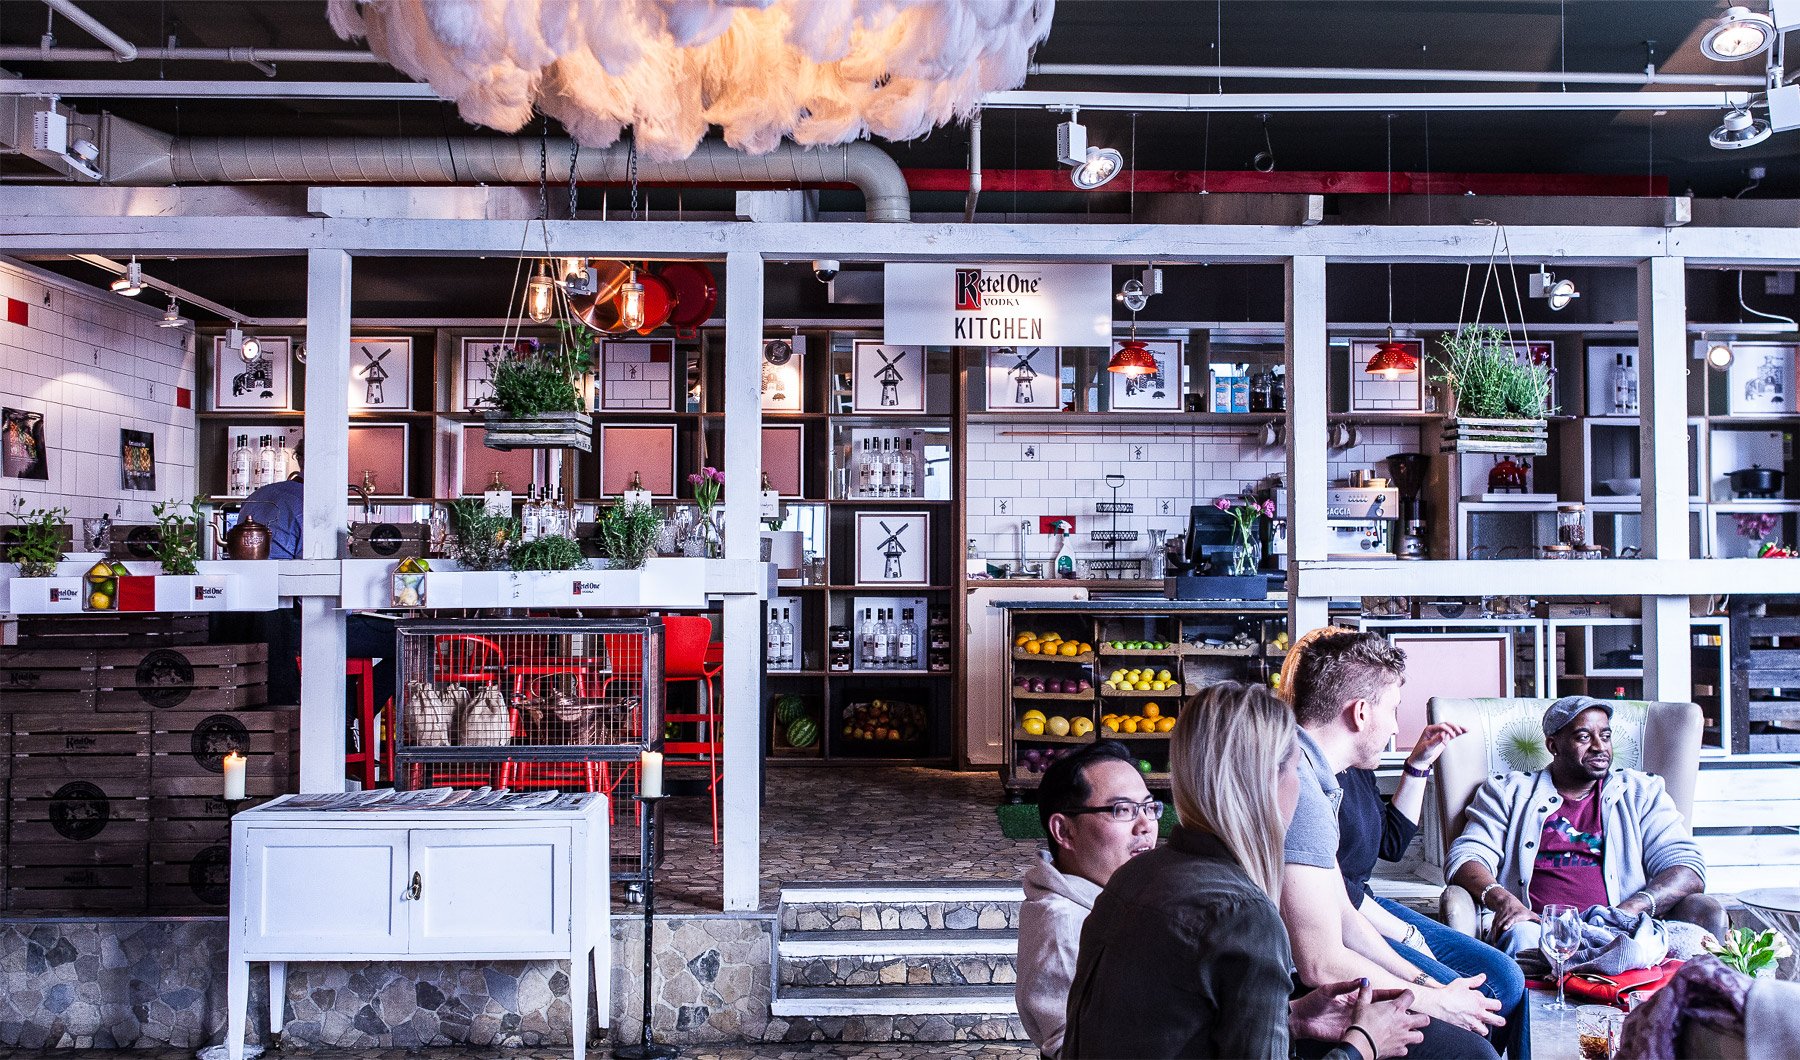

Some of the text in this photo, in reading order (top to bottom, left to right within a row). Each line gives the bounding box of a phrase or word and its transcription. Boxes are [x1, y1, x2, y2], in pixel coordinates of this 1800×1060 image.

[957, 272, 1039, 308] Ketel One
[983, 298, 1020, 306] VODKA
[955, 317, 1042, 339] KITCHEN
